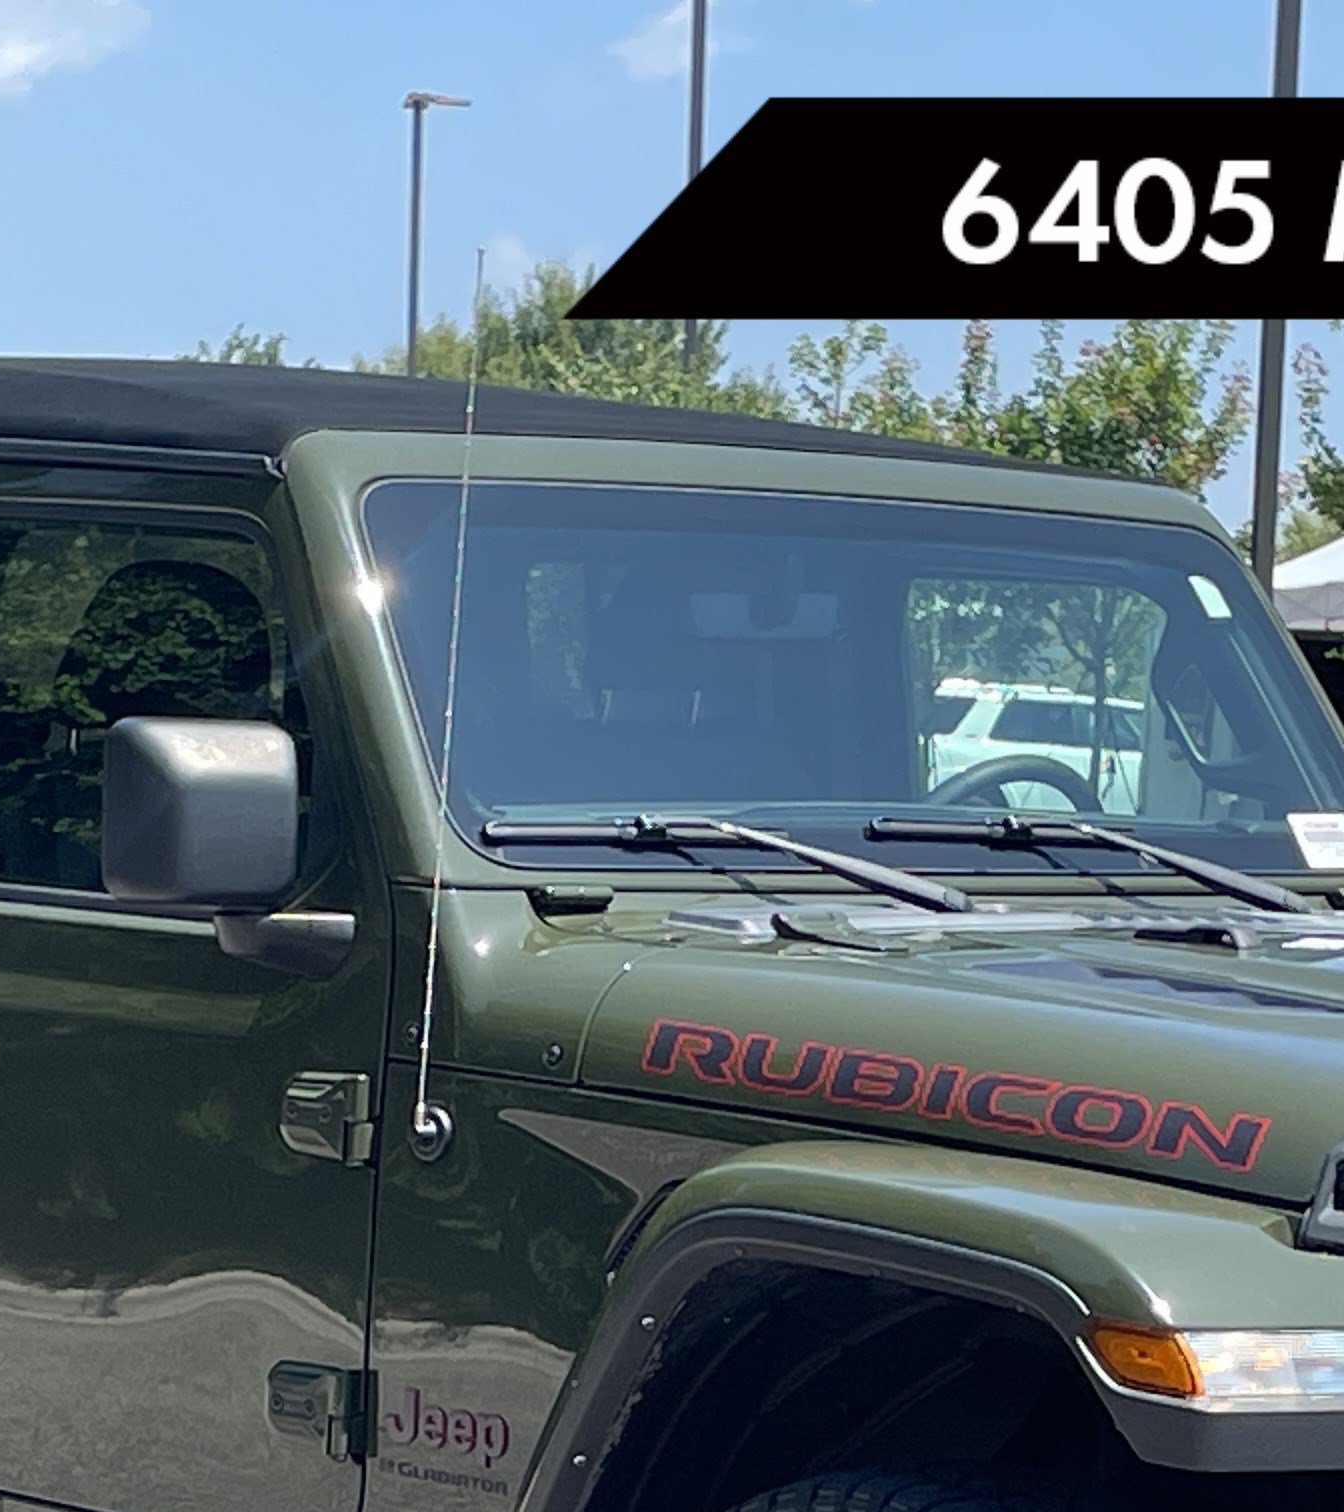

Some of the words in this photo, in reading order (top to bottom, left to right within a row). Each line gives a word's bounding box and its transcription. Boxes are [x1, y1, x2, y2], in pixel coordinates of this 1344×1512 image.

[643, 1018, 1272, 1172] RUBICON
[383, 1386, 510, 1469] Jeep
[397, 1461, 509, 1495] GLADIATOR
